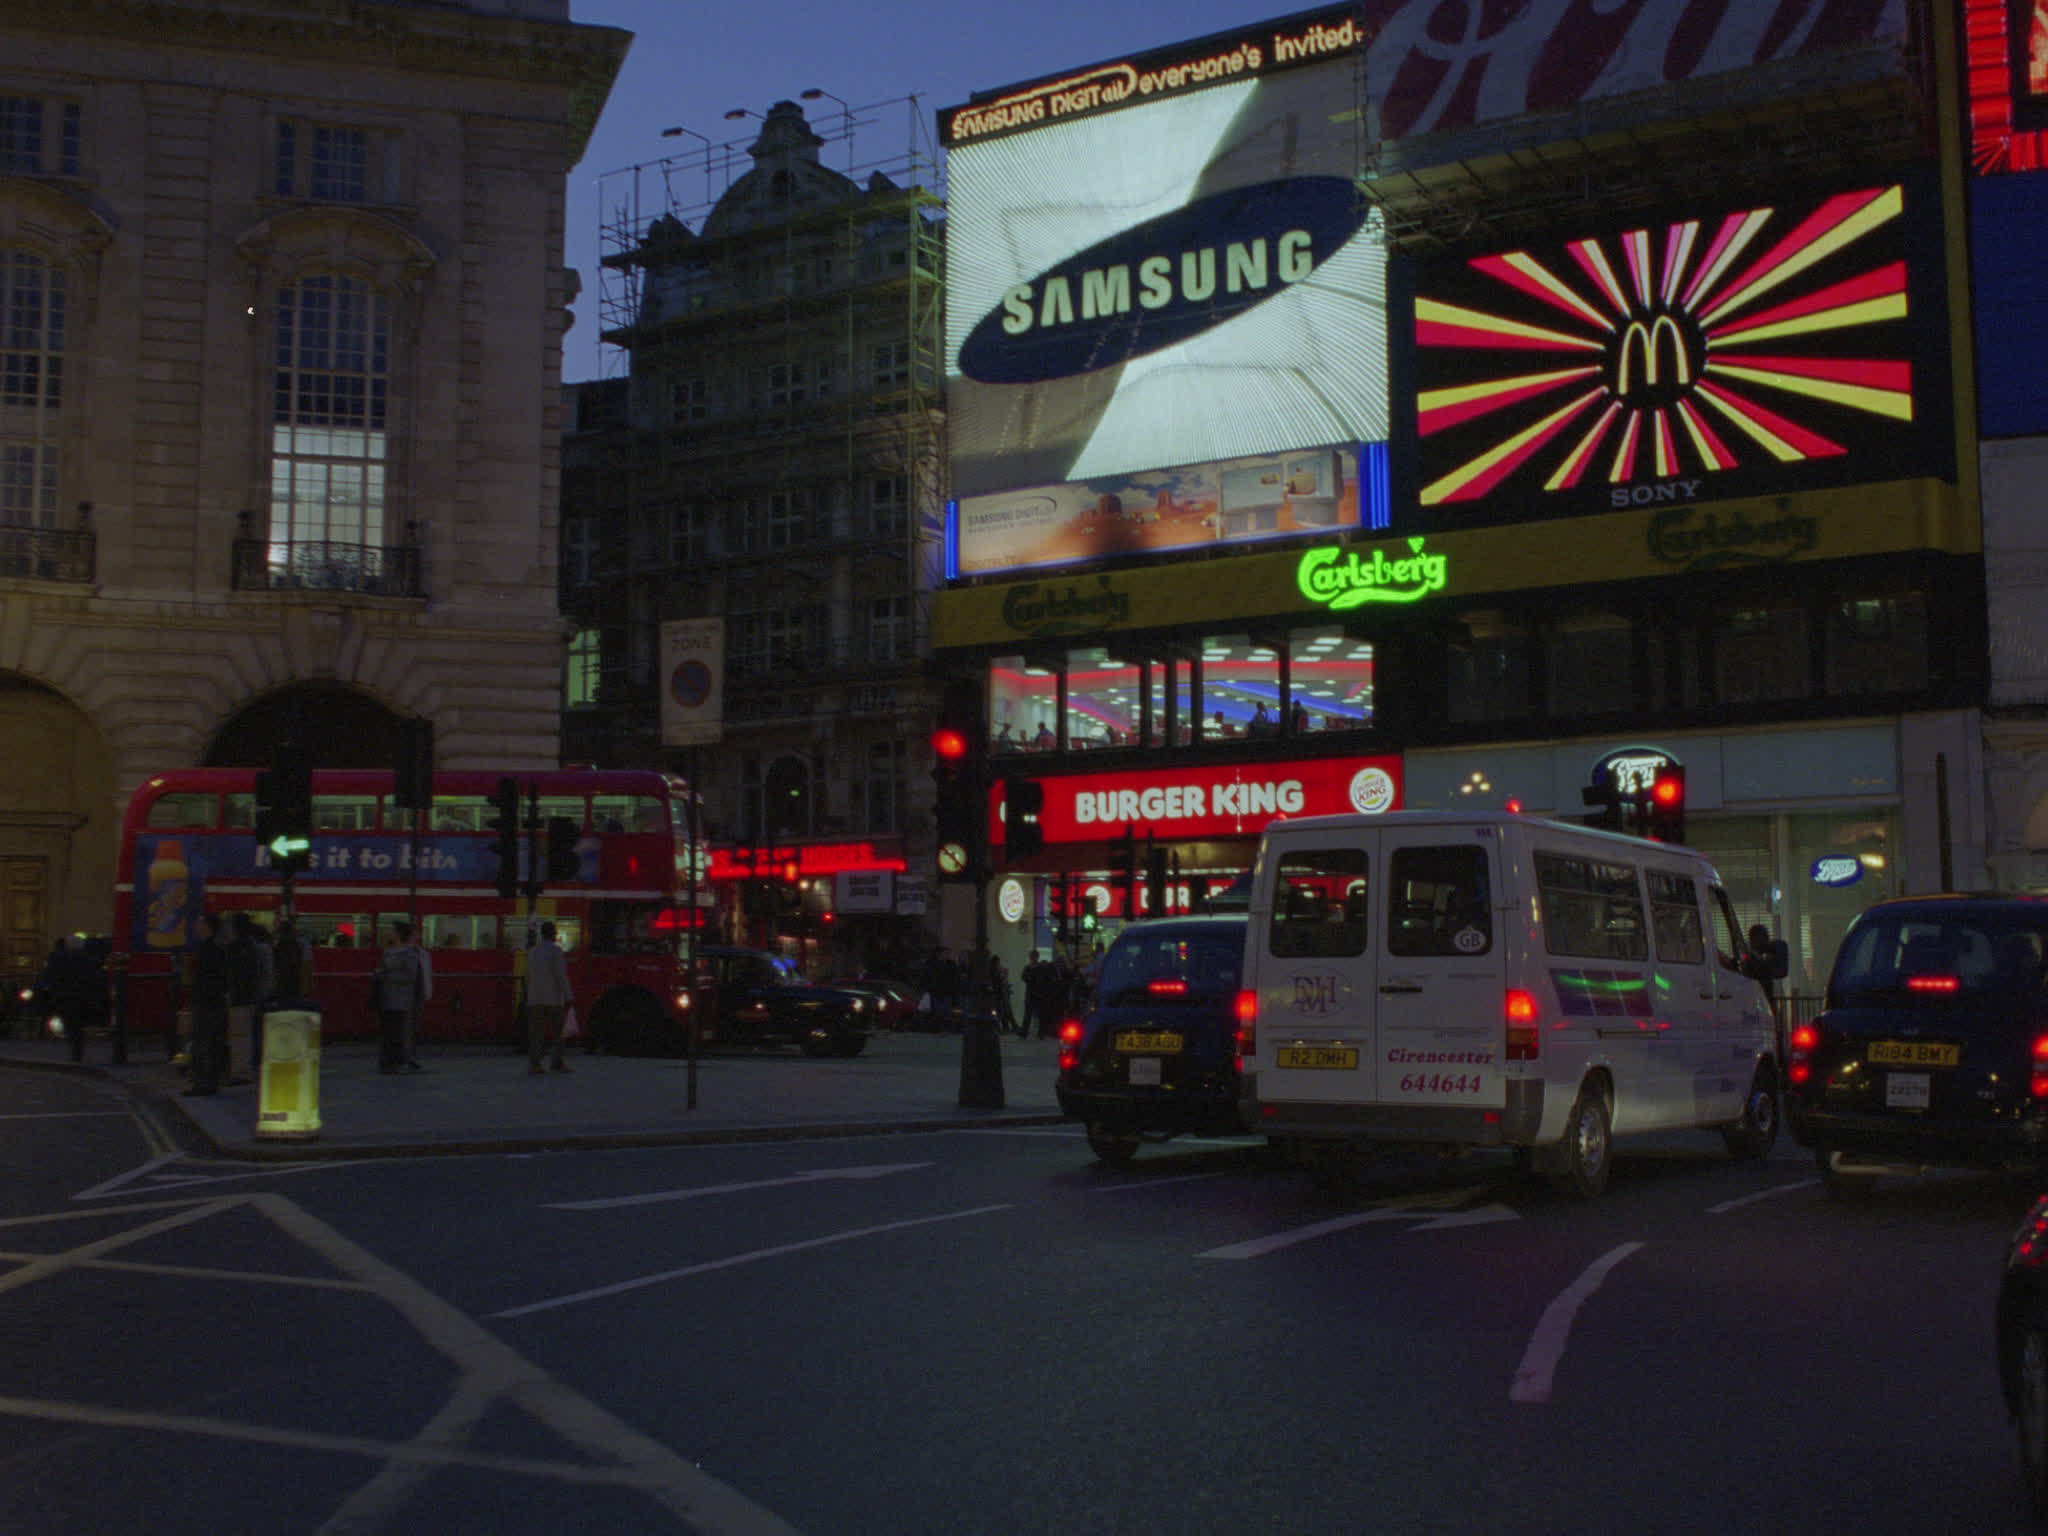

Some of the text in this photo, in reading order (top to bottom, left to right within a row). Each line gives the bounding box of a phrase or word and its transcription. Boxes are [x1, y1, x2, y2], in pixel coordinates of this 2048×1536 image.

[952, 100, 1045, 140] SAMSUNG
[1139, 42, 1264, 94] everyone's
[1002, 229, 1313, 334] SAMSUNG
[1610, 480, 1702, 508] SONY
[1297, 546, 1447, 610] Carlsberg
[1076, 780, 1305, 823] BURGER KING
[327, 845, 353, 868] it
[360, 847, 391, 868] to
[1460, 933, 1480, 947] GB
[1387, 1048, 1494, 1065] Cirencester
[1400, 1073, 1481, 1093] 644644
